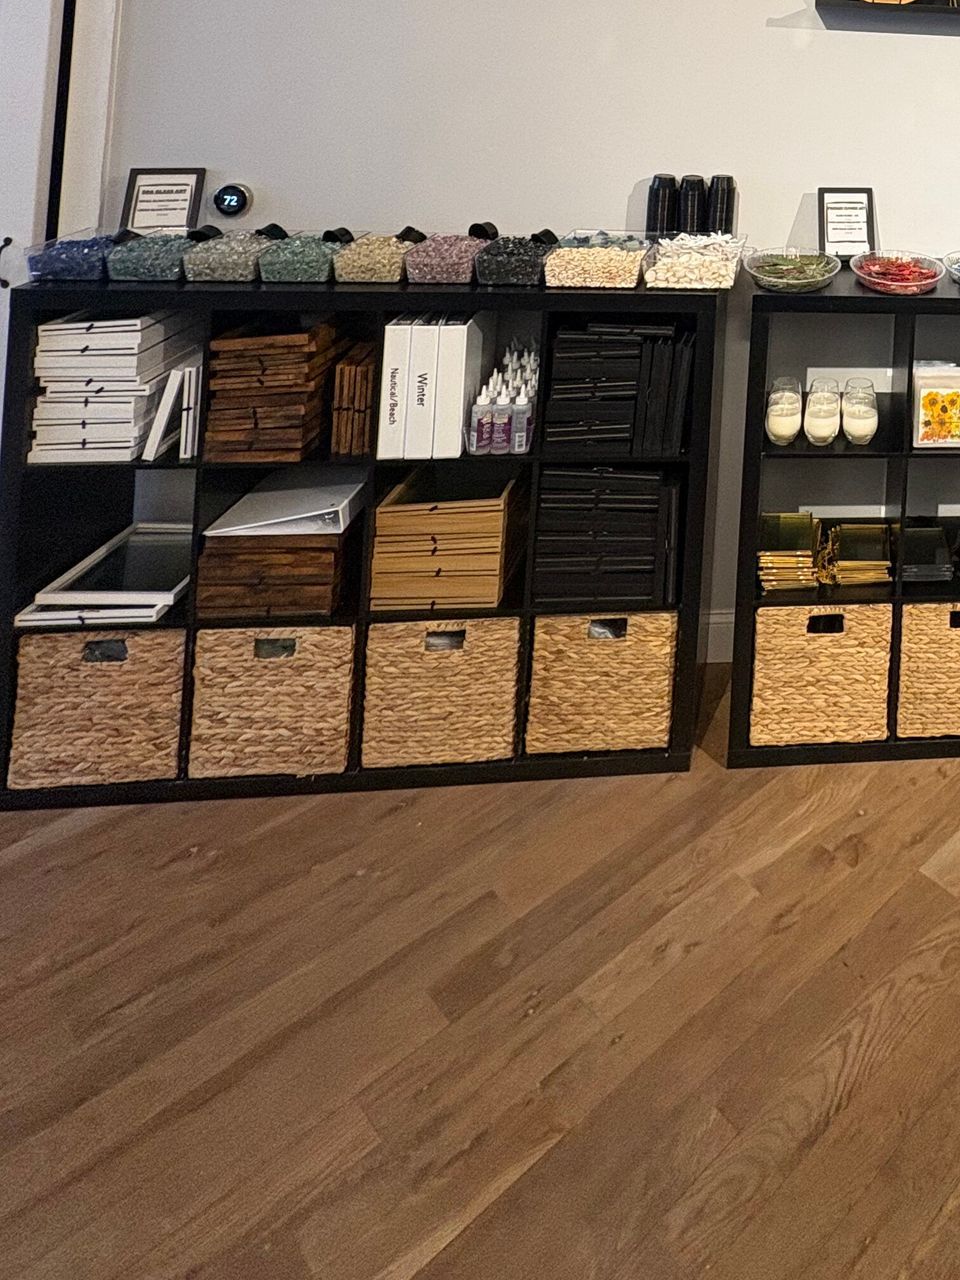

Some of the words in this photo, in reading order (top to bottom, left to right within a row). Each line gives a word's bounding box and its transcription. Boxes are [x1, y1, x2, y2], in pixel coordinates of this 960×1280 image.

[223, 195, 238, 205] 72
[388, 367, 399, 425] Nautical/Beach
[416, 372, 428, 407] Winter
